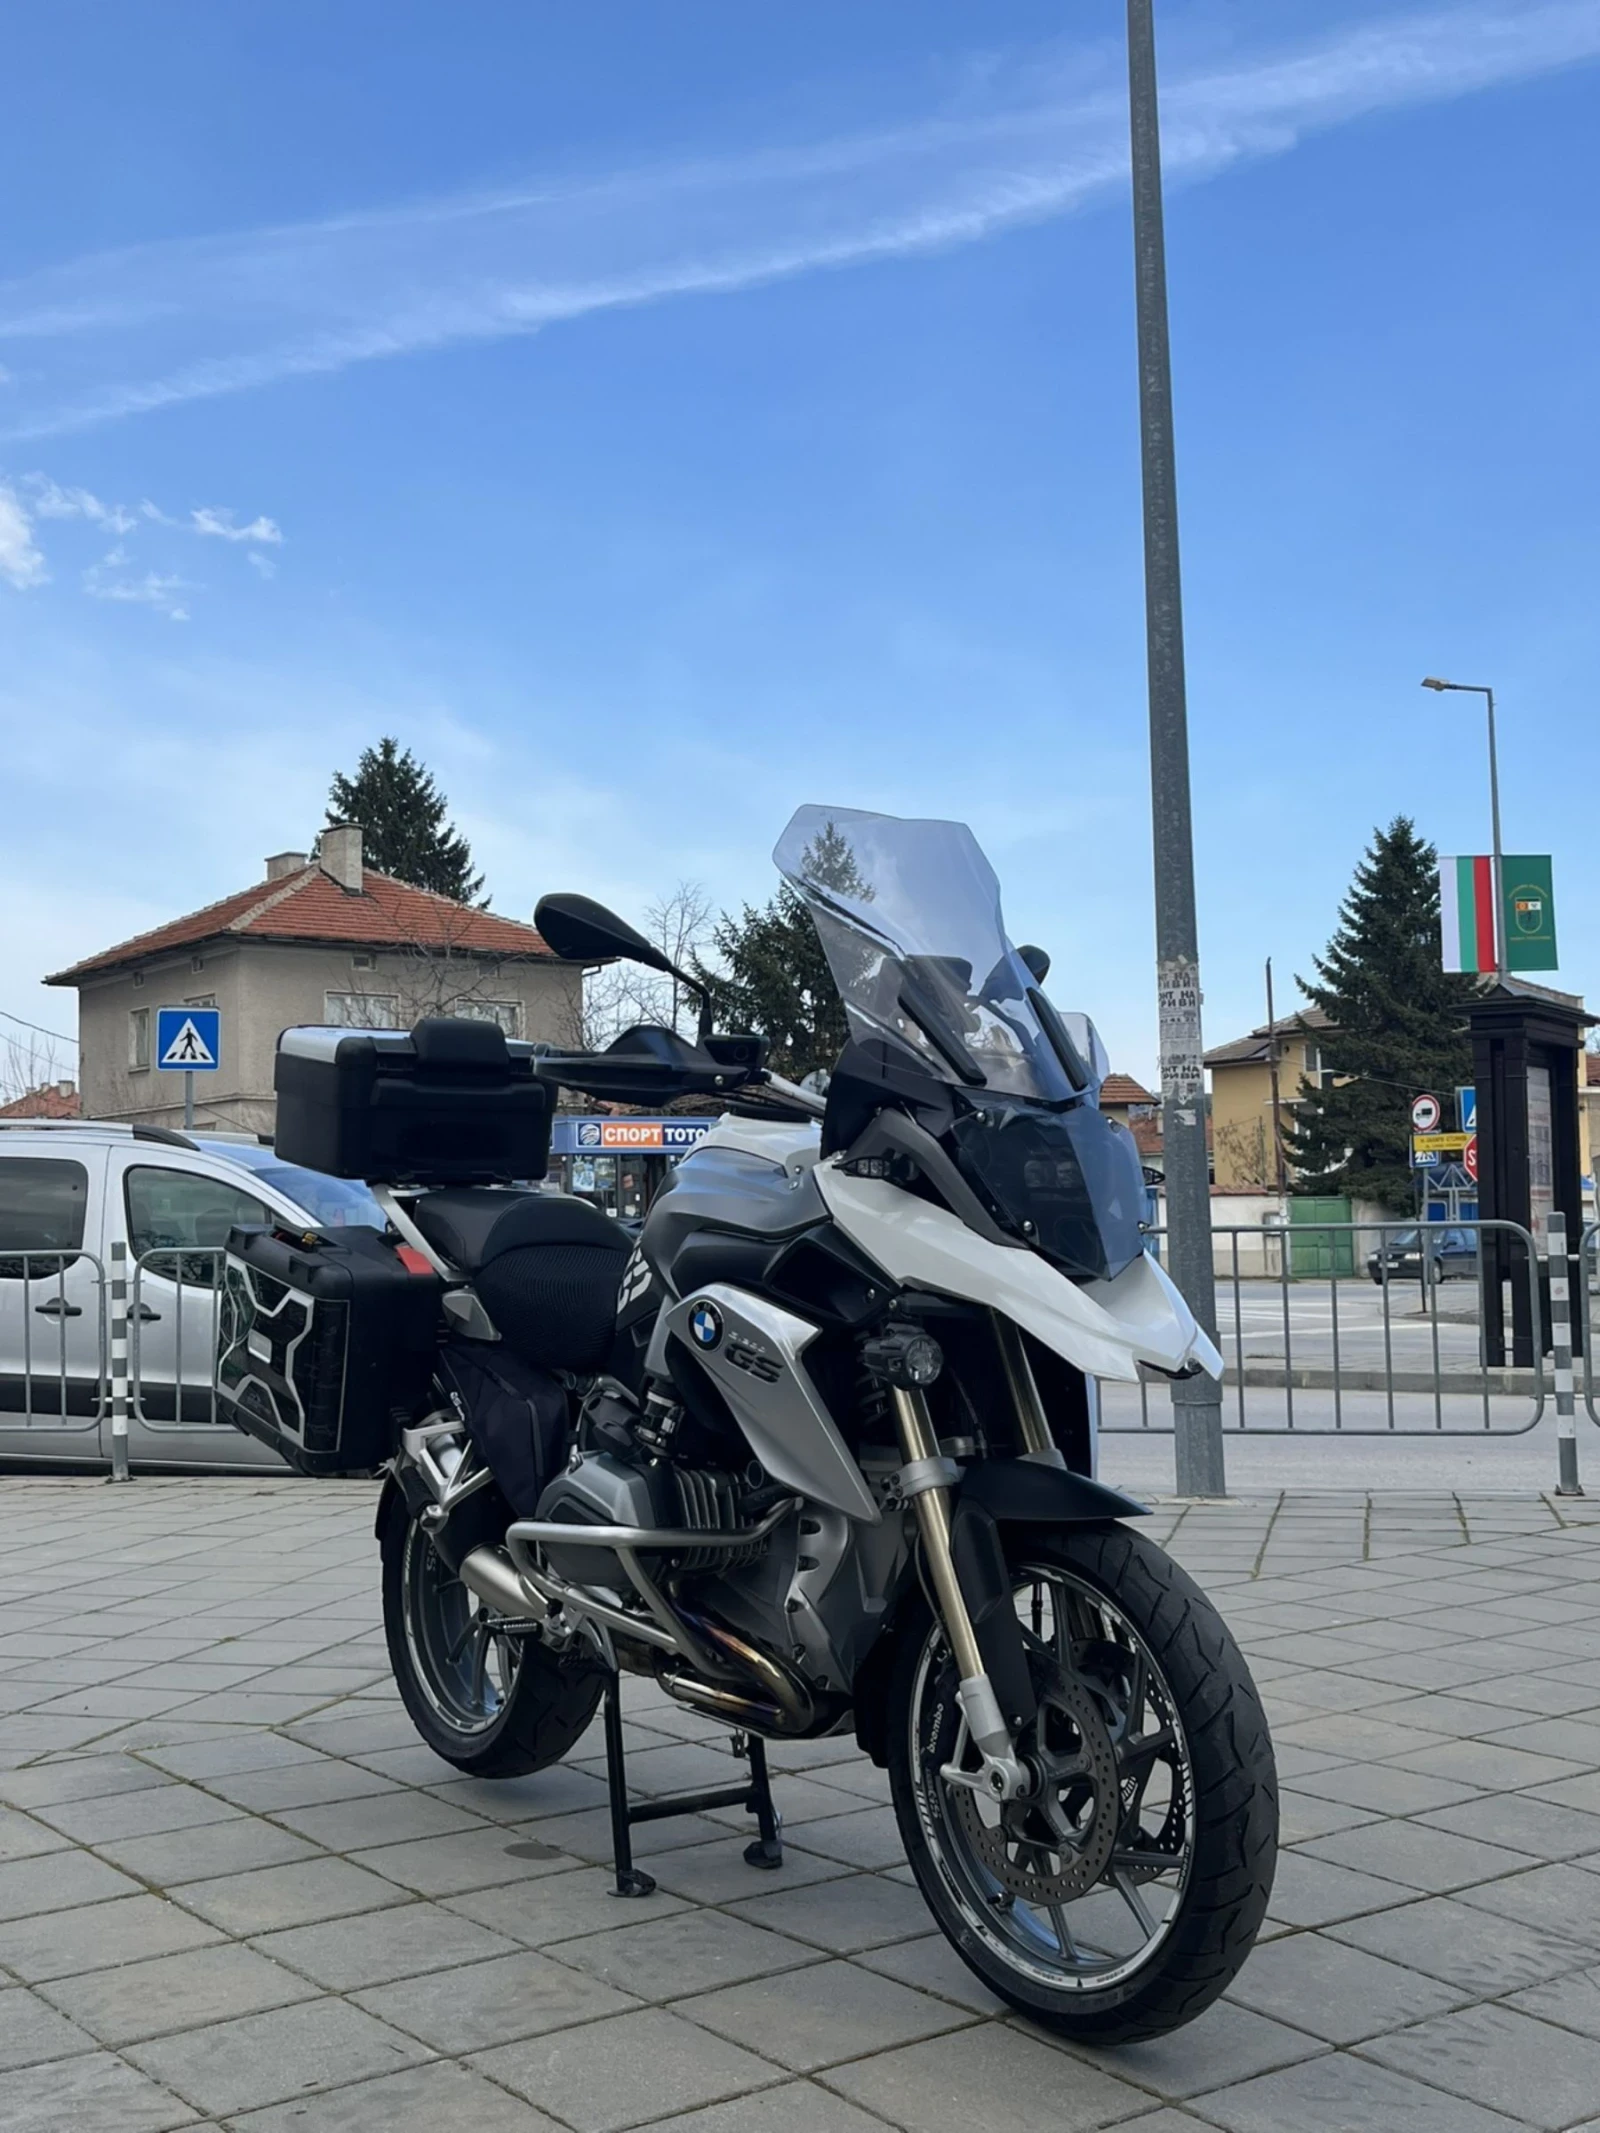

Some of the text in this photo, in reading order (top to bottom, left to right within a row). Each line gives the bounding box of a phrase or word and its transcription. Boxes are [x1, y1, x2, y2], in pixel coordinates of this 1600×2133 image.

[1159, 979, 1191, 988] ИВИ
[1181, 990, 1195, 998] НА
[1183, 1065, 1199, 1073] НА
[604, 1128, 706, 1142] СПОРТ ТОТО
[725, 1342, 784, 1384] GS
[926, 1702, 944, 1754] brembo
